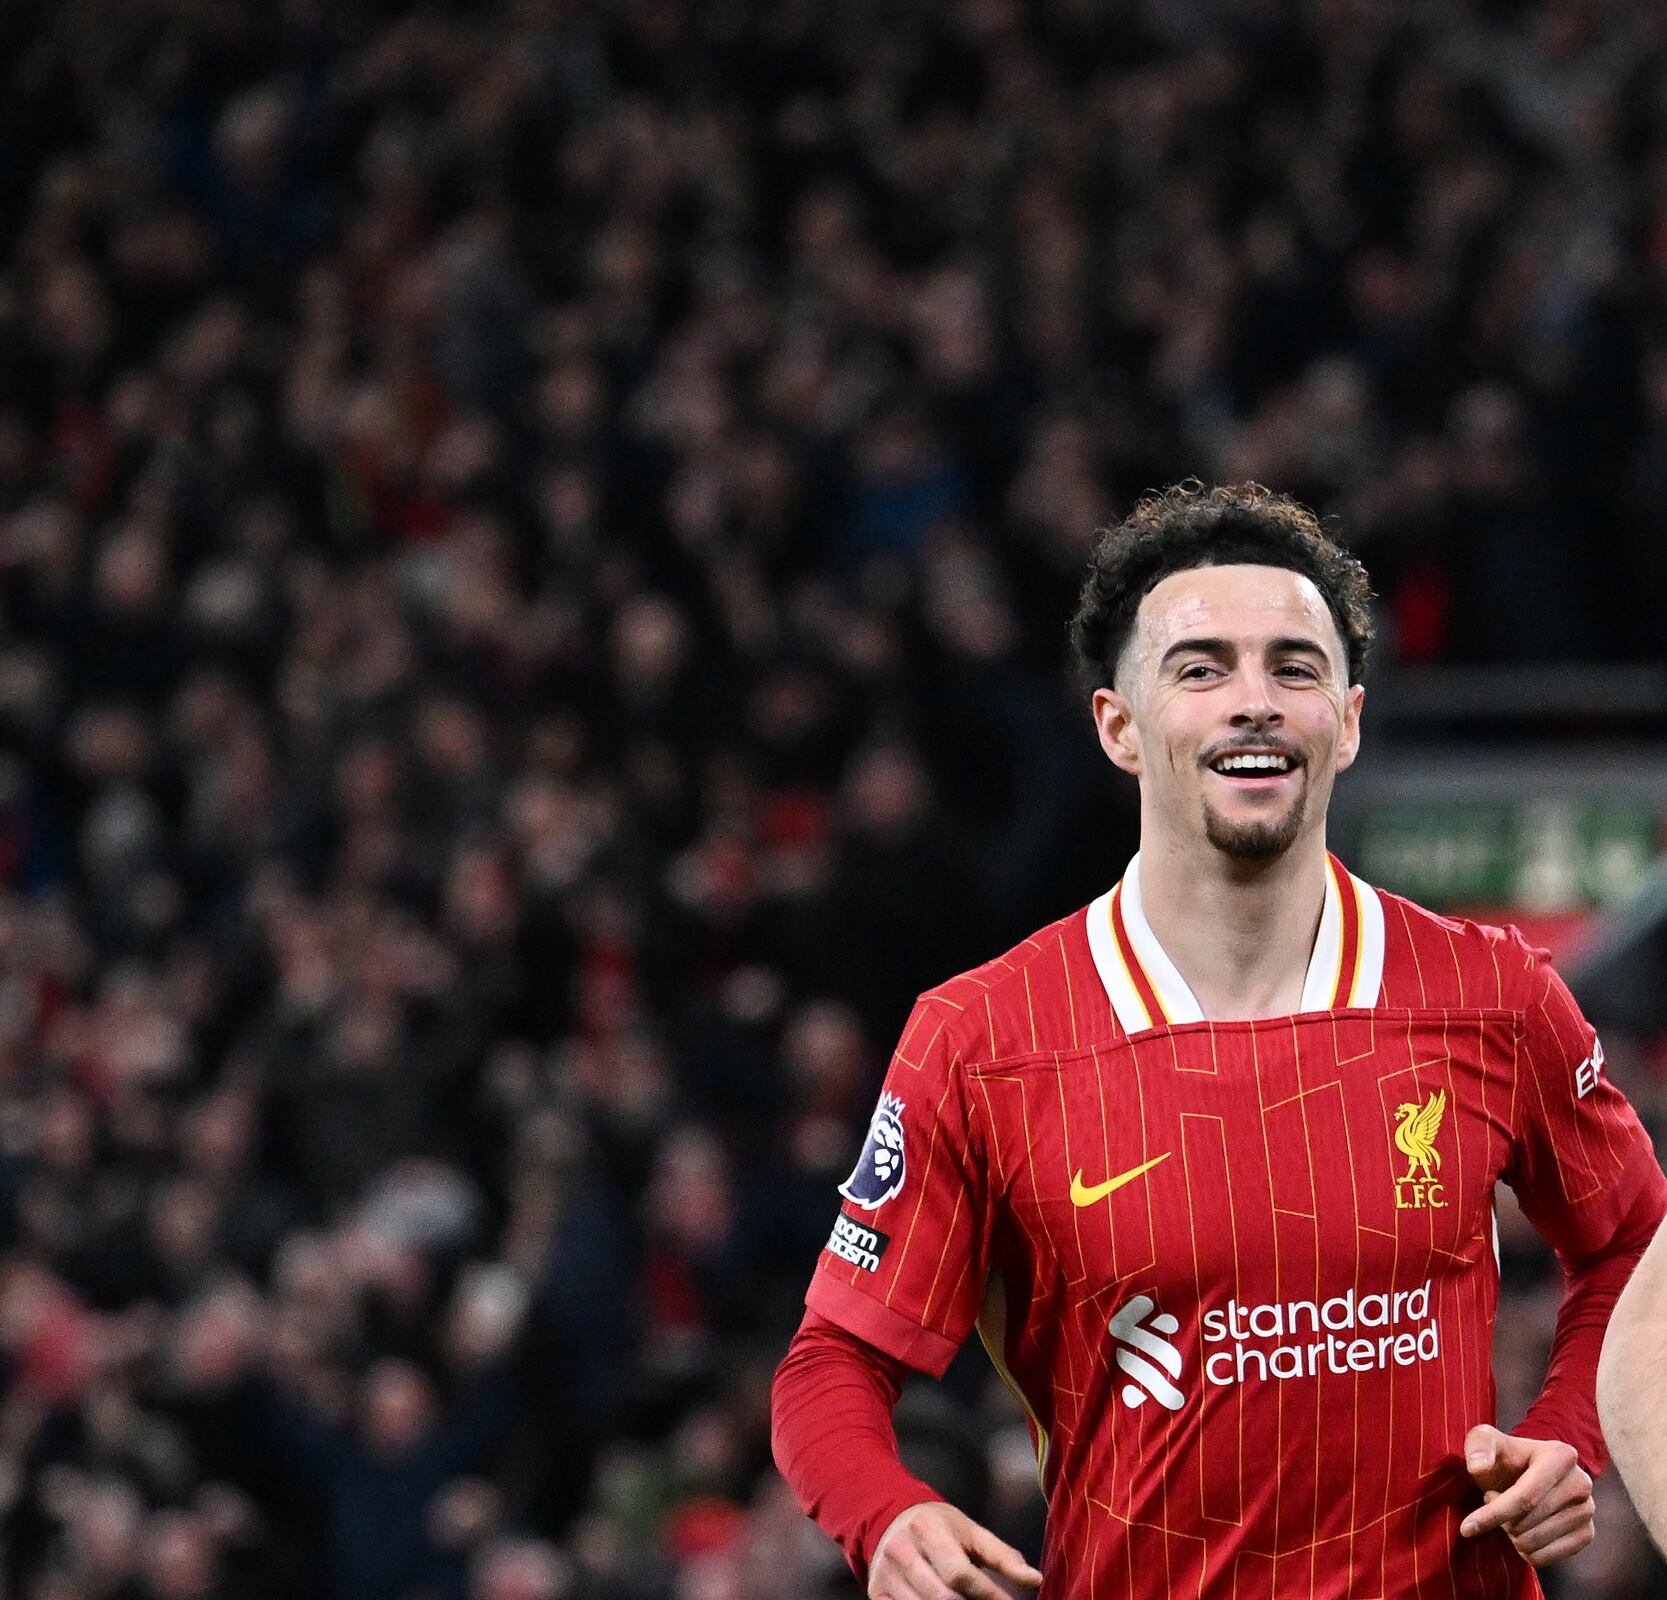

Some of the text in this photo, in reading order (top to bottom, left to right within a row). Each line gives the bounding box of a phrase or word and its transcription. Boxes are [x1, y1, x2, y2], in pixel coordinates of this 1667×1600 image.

[1395, 1184, 1449, 1209] L.F.C.
[1203, 1278, 1432, 1343] standard
[1205, 1318, 1440, 1386] chartered
